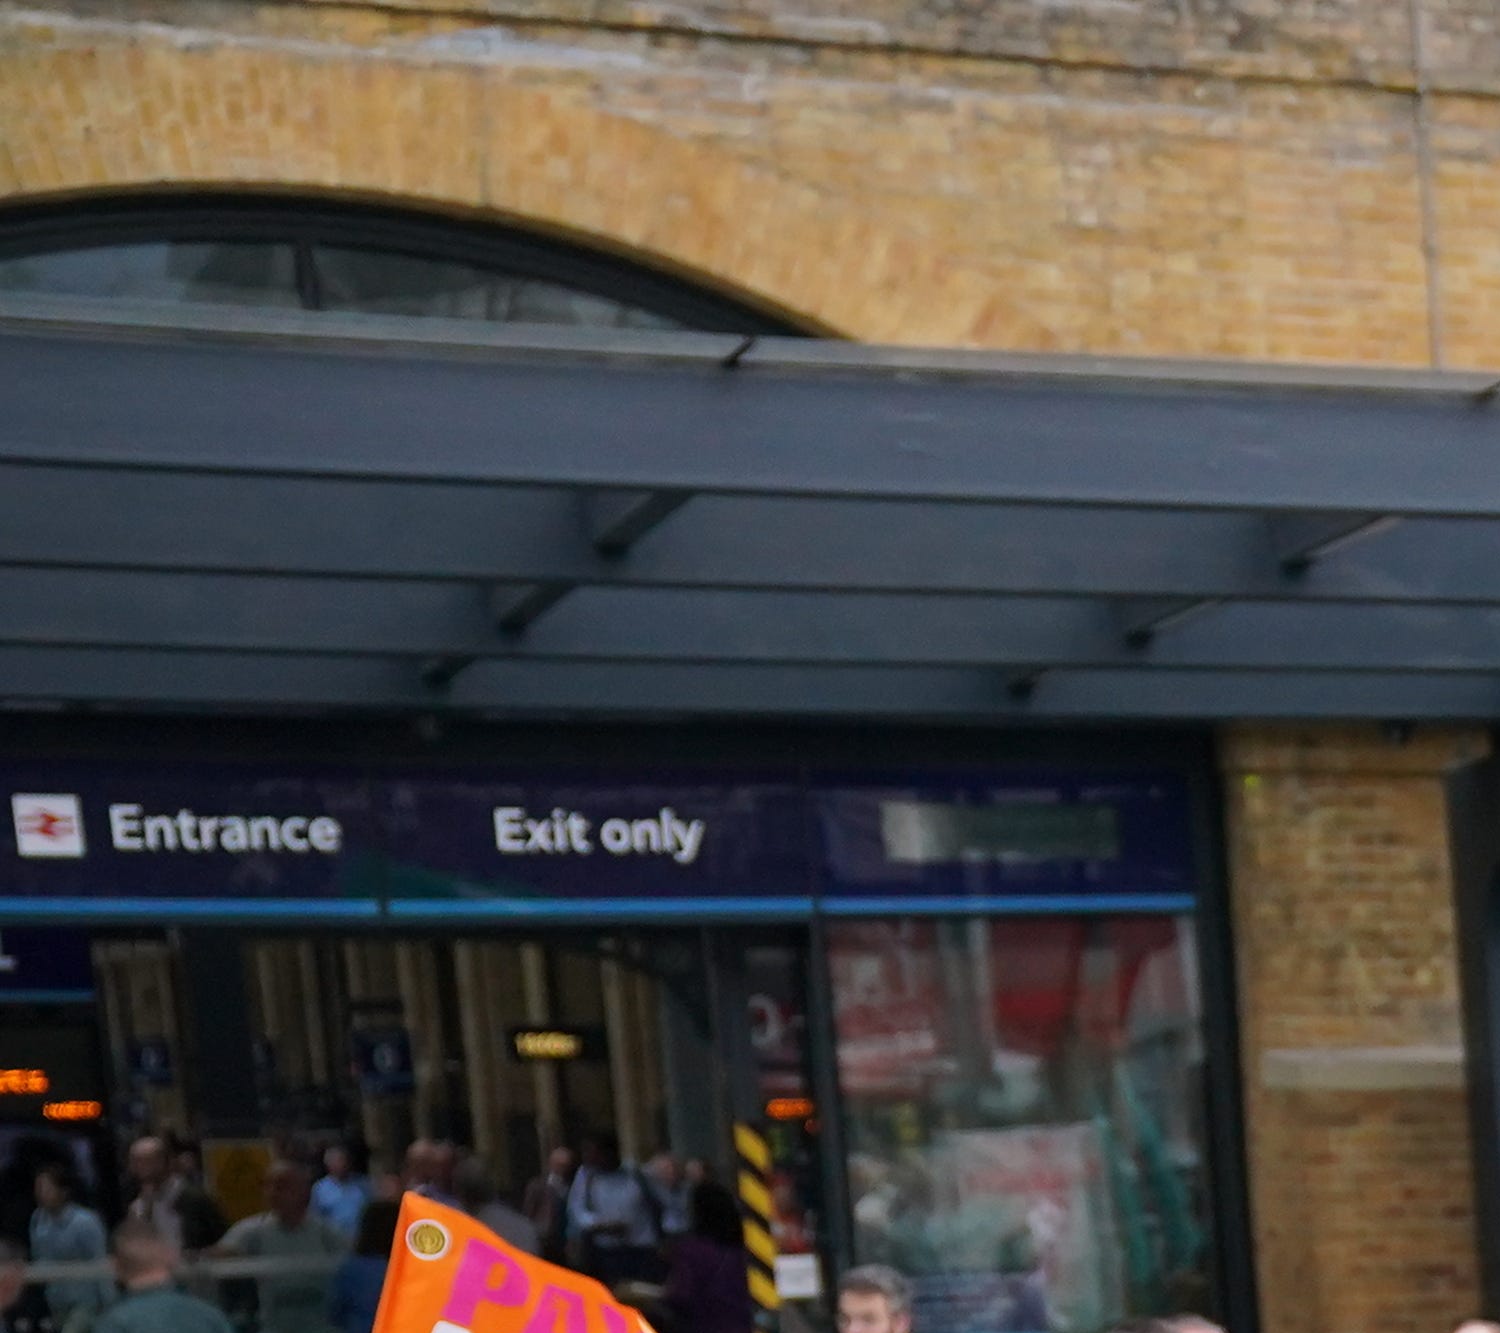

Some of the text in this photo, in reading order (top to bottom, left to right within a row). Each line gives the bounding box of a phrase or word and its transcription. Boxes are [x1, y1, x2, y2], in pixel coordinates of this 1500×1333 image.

[110, 804, 342, 854] Entrance
[493, 806, 704, 864] Exit only
